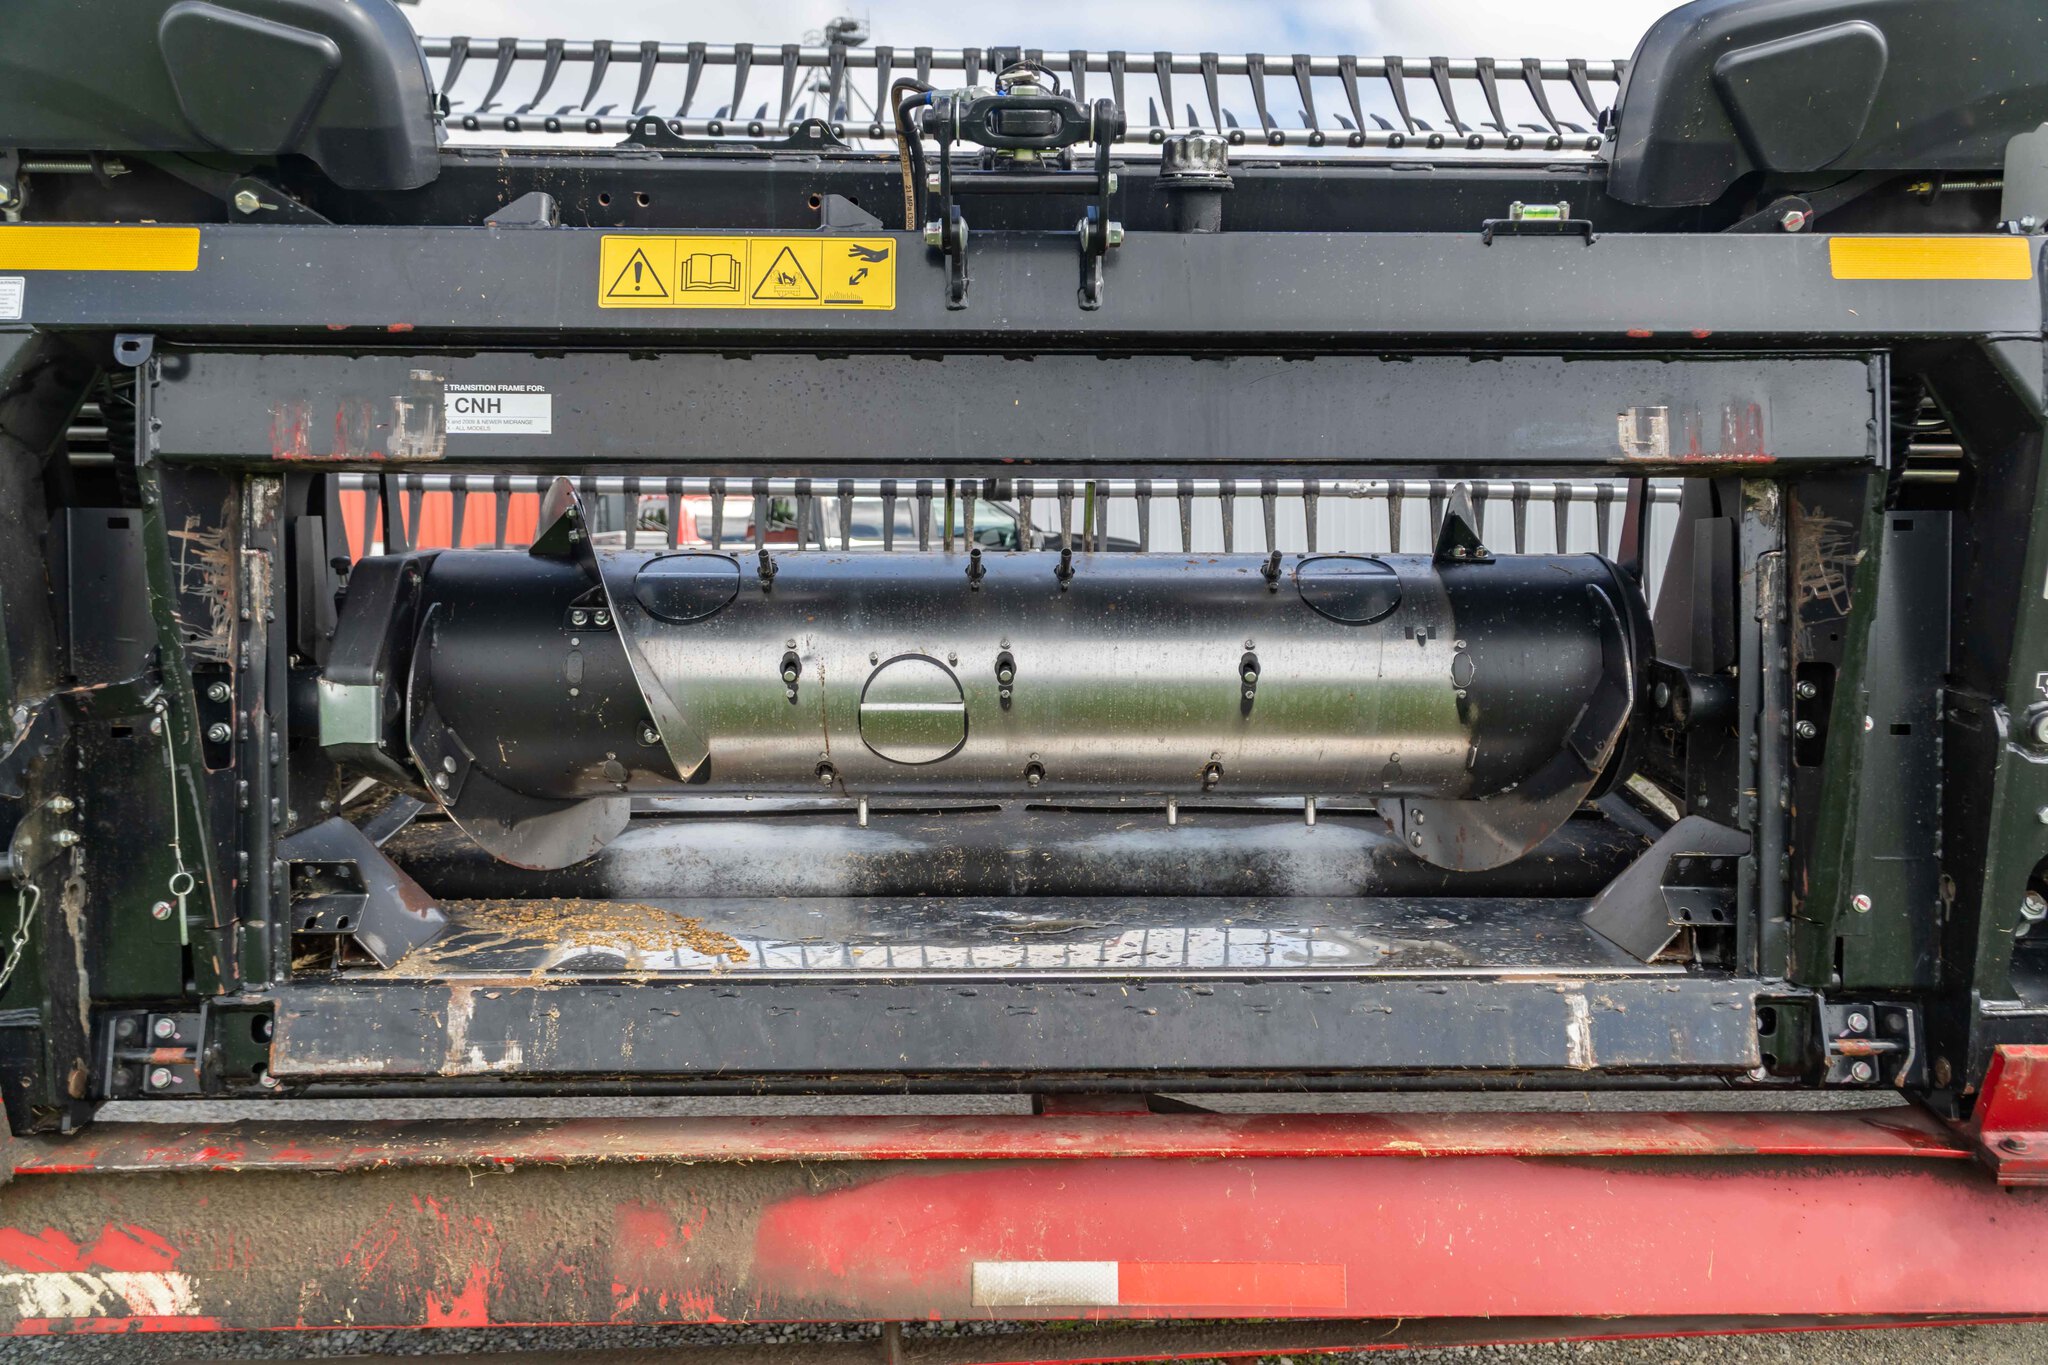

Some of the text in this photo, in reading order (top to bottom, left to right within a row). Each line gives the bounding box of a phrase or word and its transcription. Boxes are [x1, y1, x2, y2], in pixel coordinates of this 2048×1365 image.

[905, 184, 912, 193] 21
[497, 384, 525, 392] FRAME
[454, 397, 502, 414] CNH
